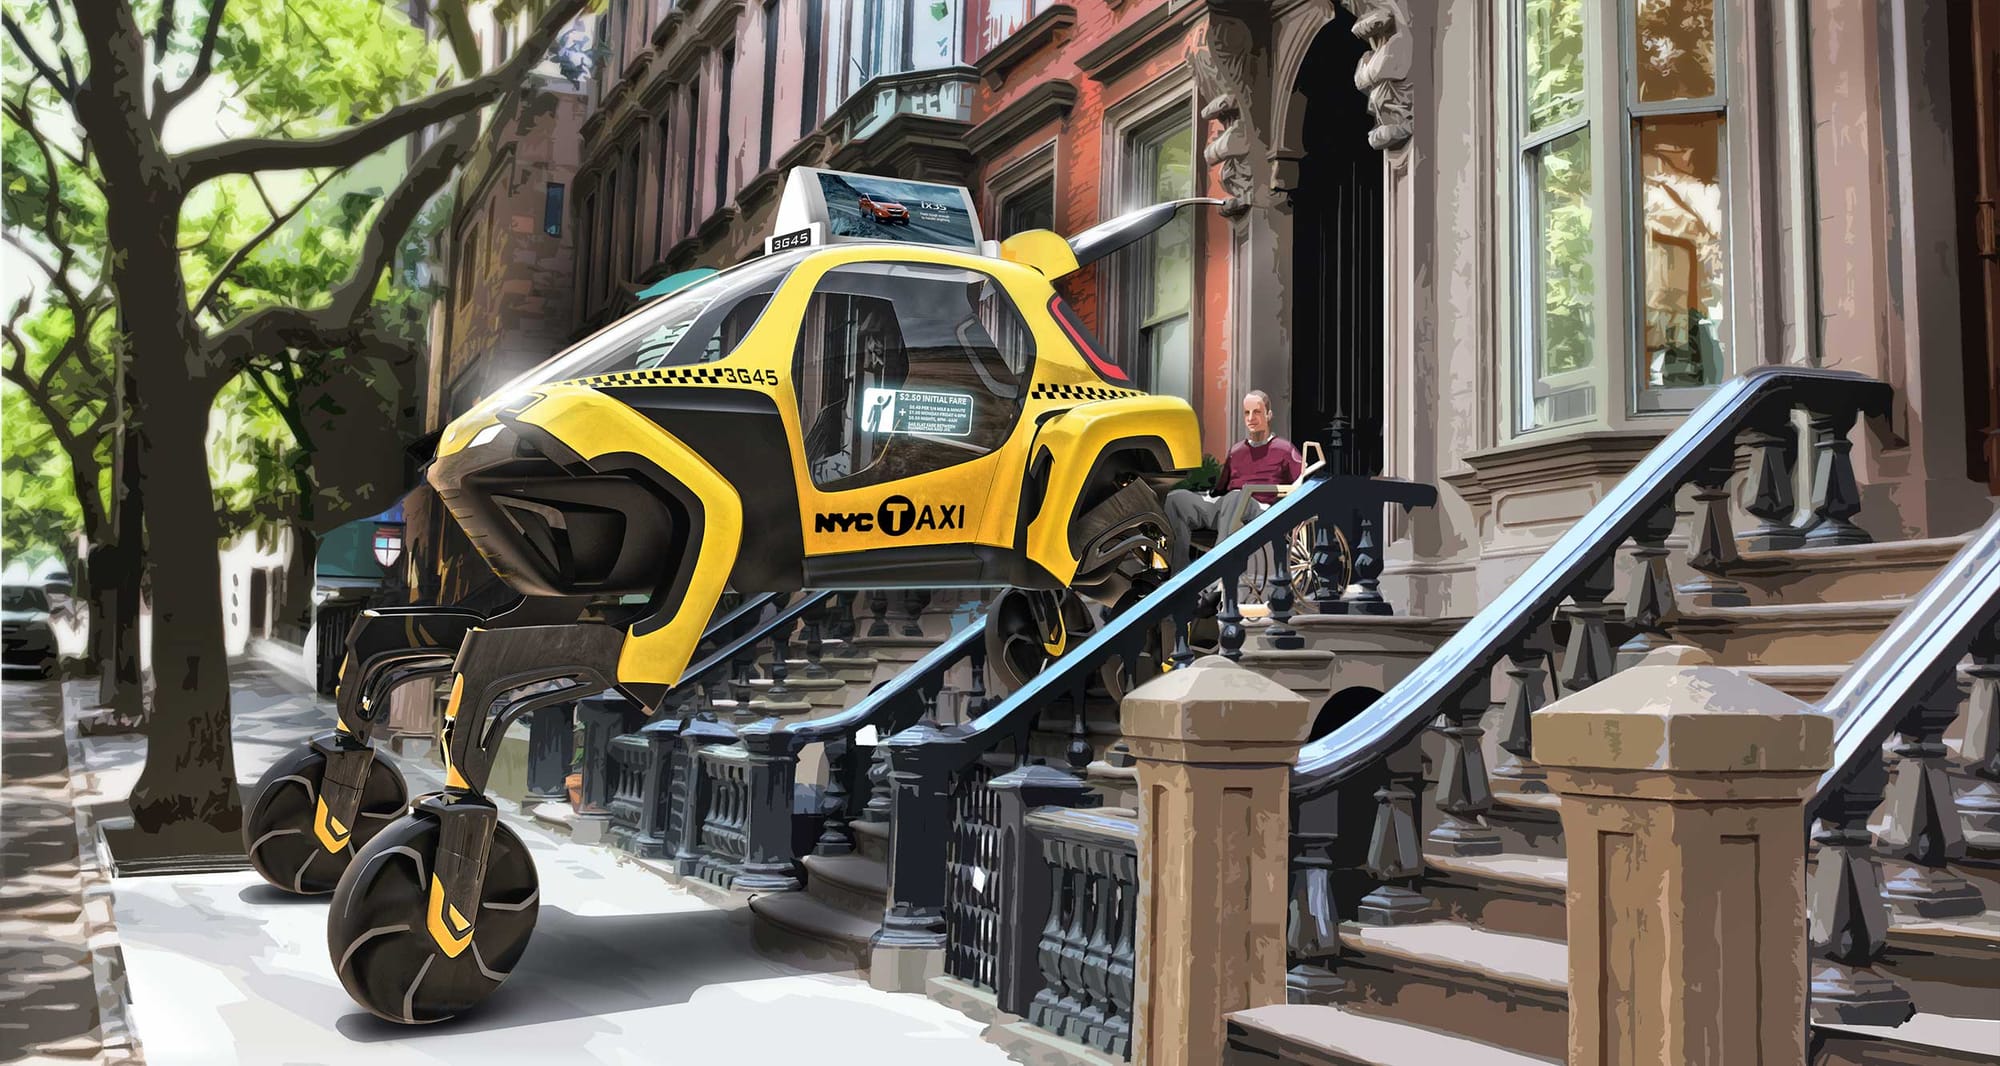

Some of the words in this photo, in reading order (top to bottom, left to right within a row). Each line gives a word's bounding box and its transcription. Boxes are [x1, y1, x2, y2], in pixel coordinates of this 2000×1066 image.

[774, 232, 808, 250] 3G45
[723, 368, 779, 386] 3G45
[899, 393, 921, 402] $2.50
[922, 395, 948, 404] INITIAL
[949, 397, 967, 405] FARE
[815, 513, 873, 533] NYC
[879, 496, 965, 535] TAXI
